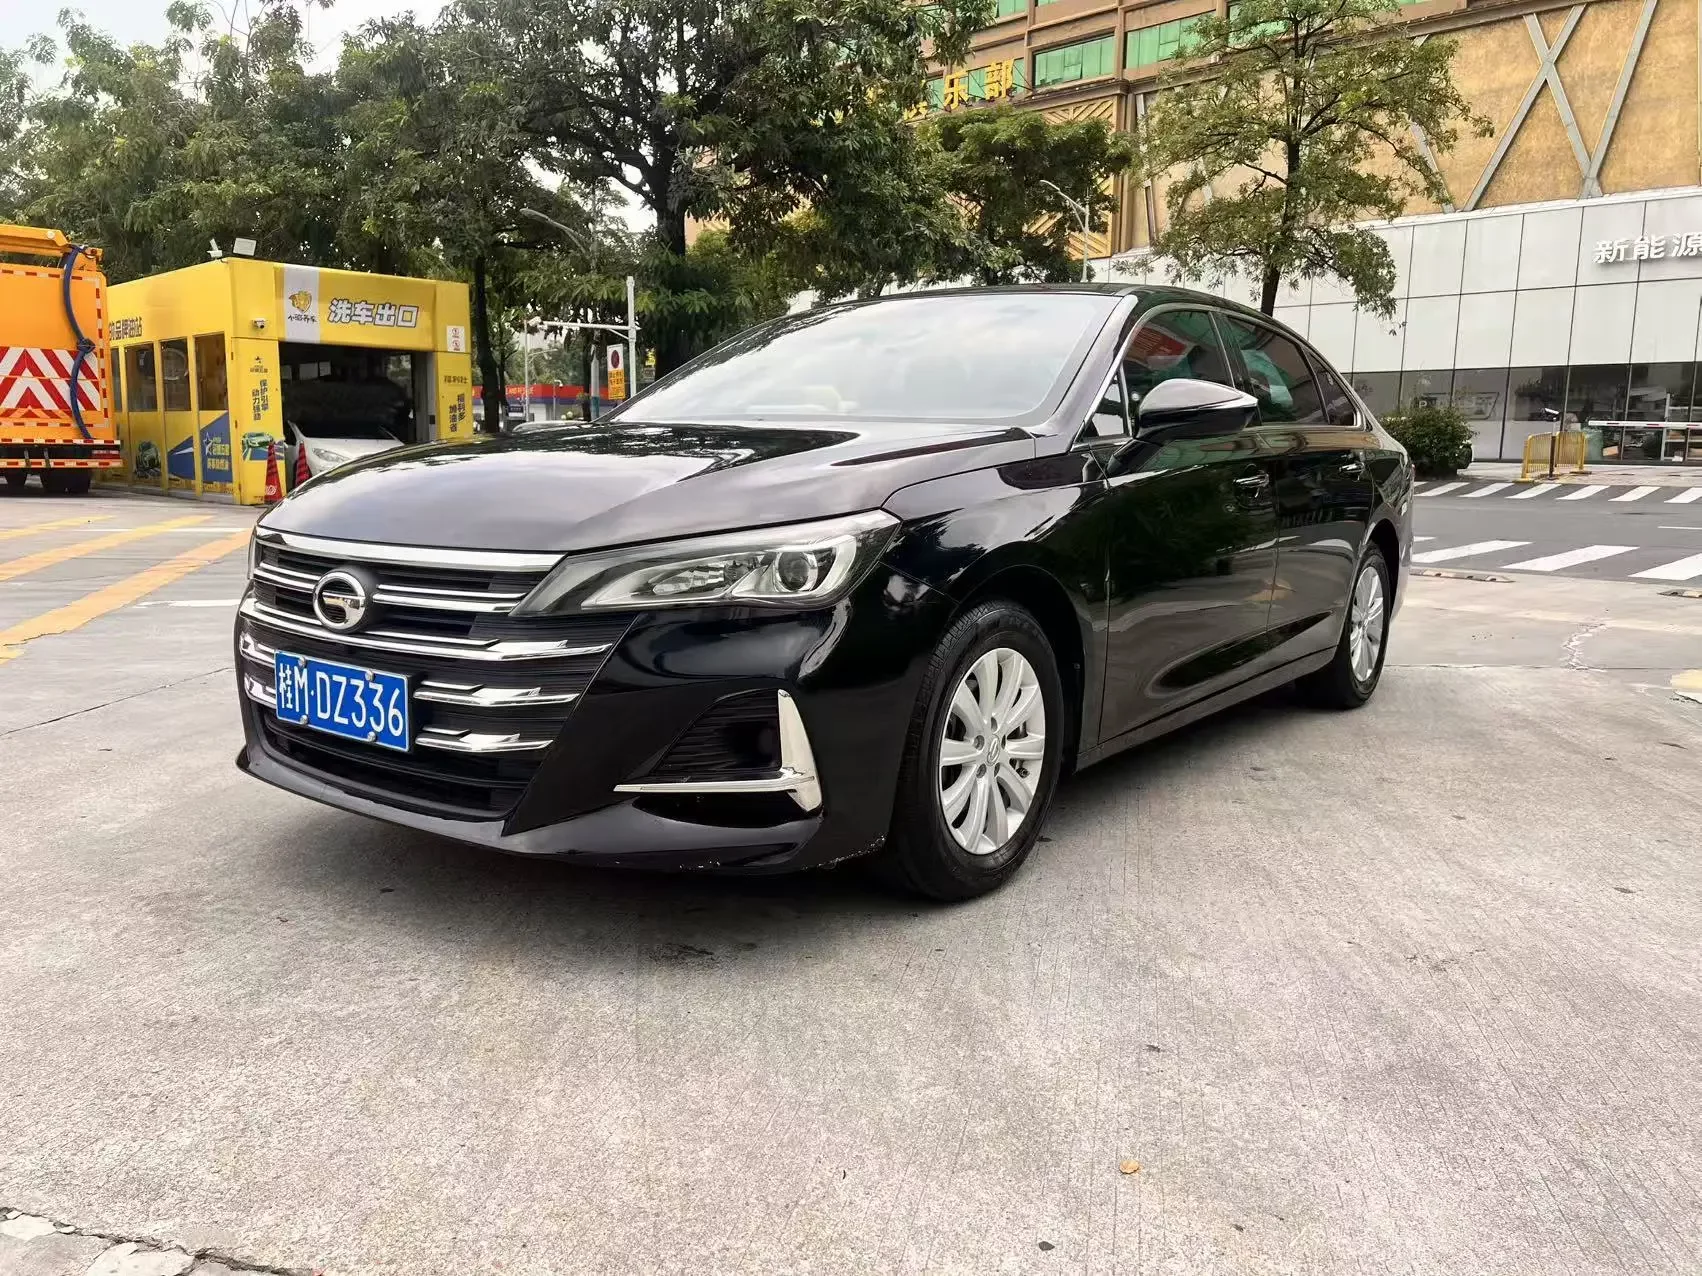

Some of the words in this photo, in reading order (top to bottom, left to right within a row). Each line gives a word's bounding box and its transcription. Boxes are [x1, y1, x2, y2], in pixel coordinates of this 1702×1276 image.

[1592, 232, 1702, 264] 新能源
[327, 298, 420, 328] 洗车出口
[279, 662, 404, 737] 桂M·DZ336
